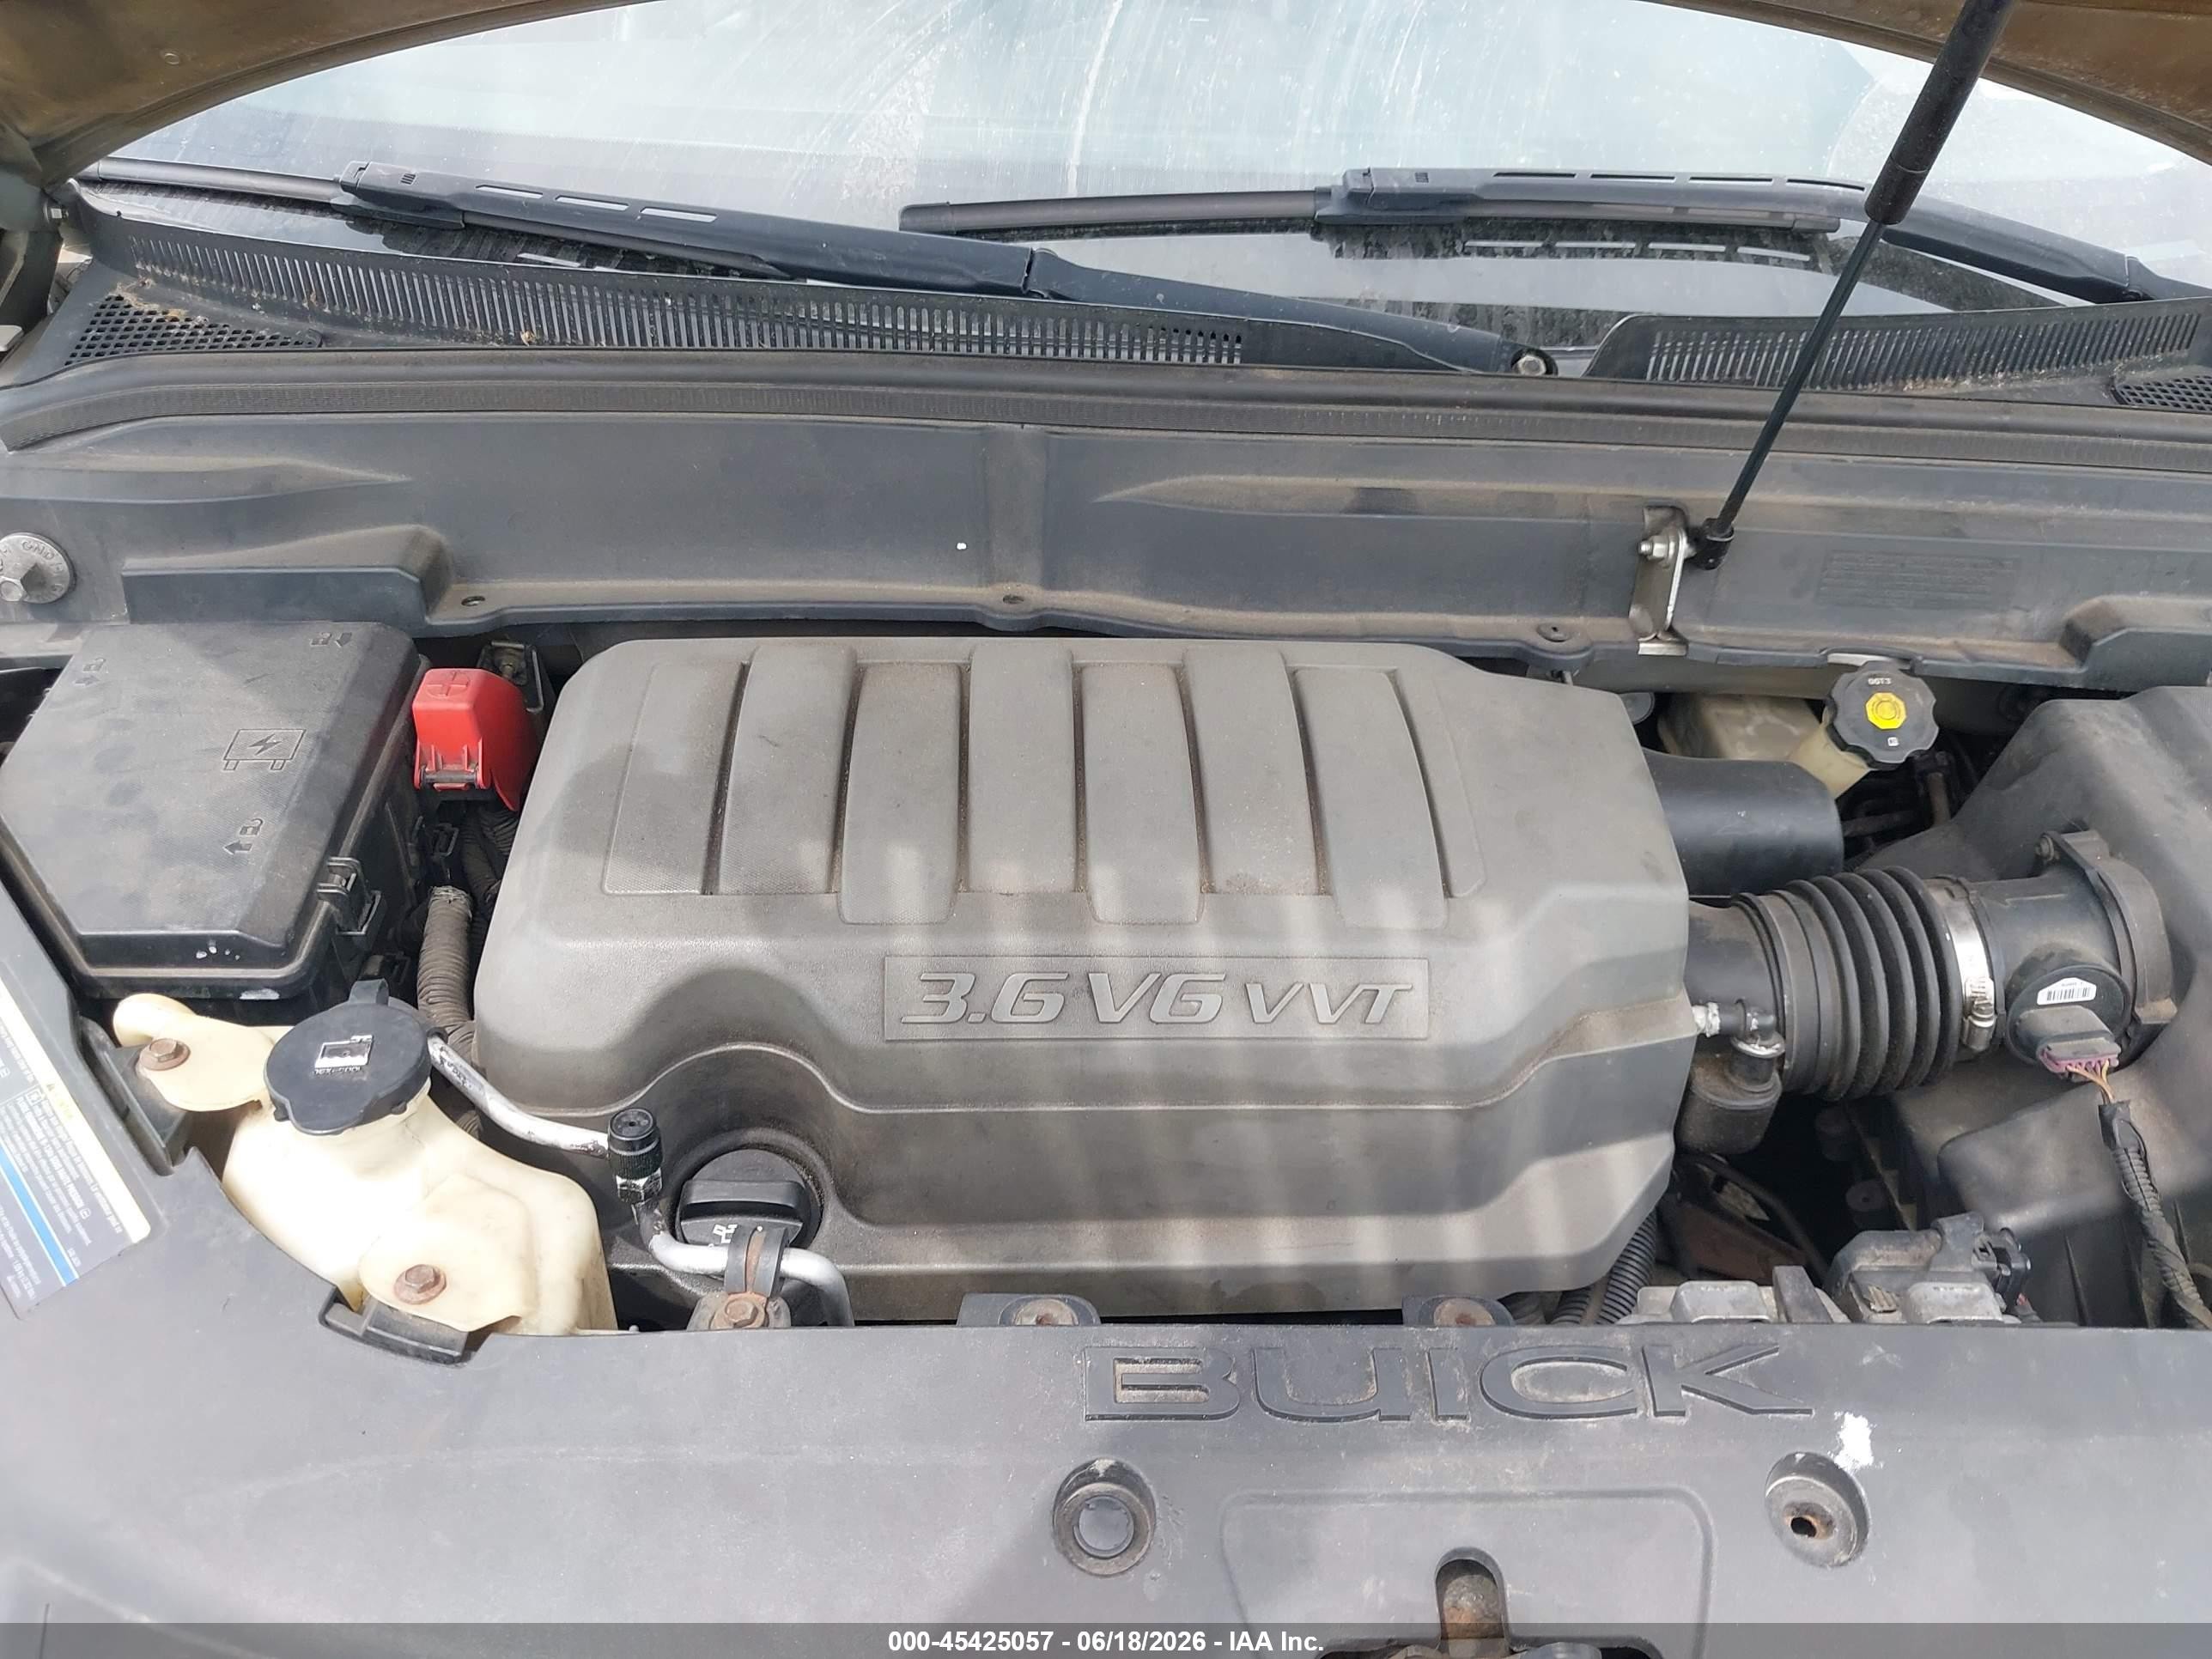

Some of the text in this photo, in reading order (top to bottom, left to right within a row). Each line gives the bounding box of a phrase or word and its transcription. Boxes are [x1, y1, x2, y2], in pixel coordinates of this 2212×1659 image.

[901, 972, 1413, 1024] 3.6 V6 VVT
[1082, 1343, 1814, 1422] BUICK
